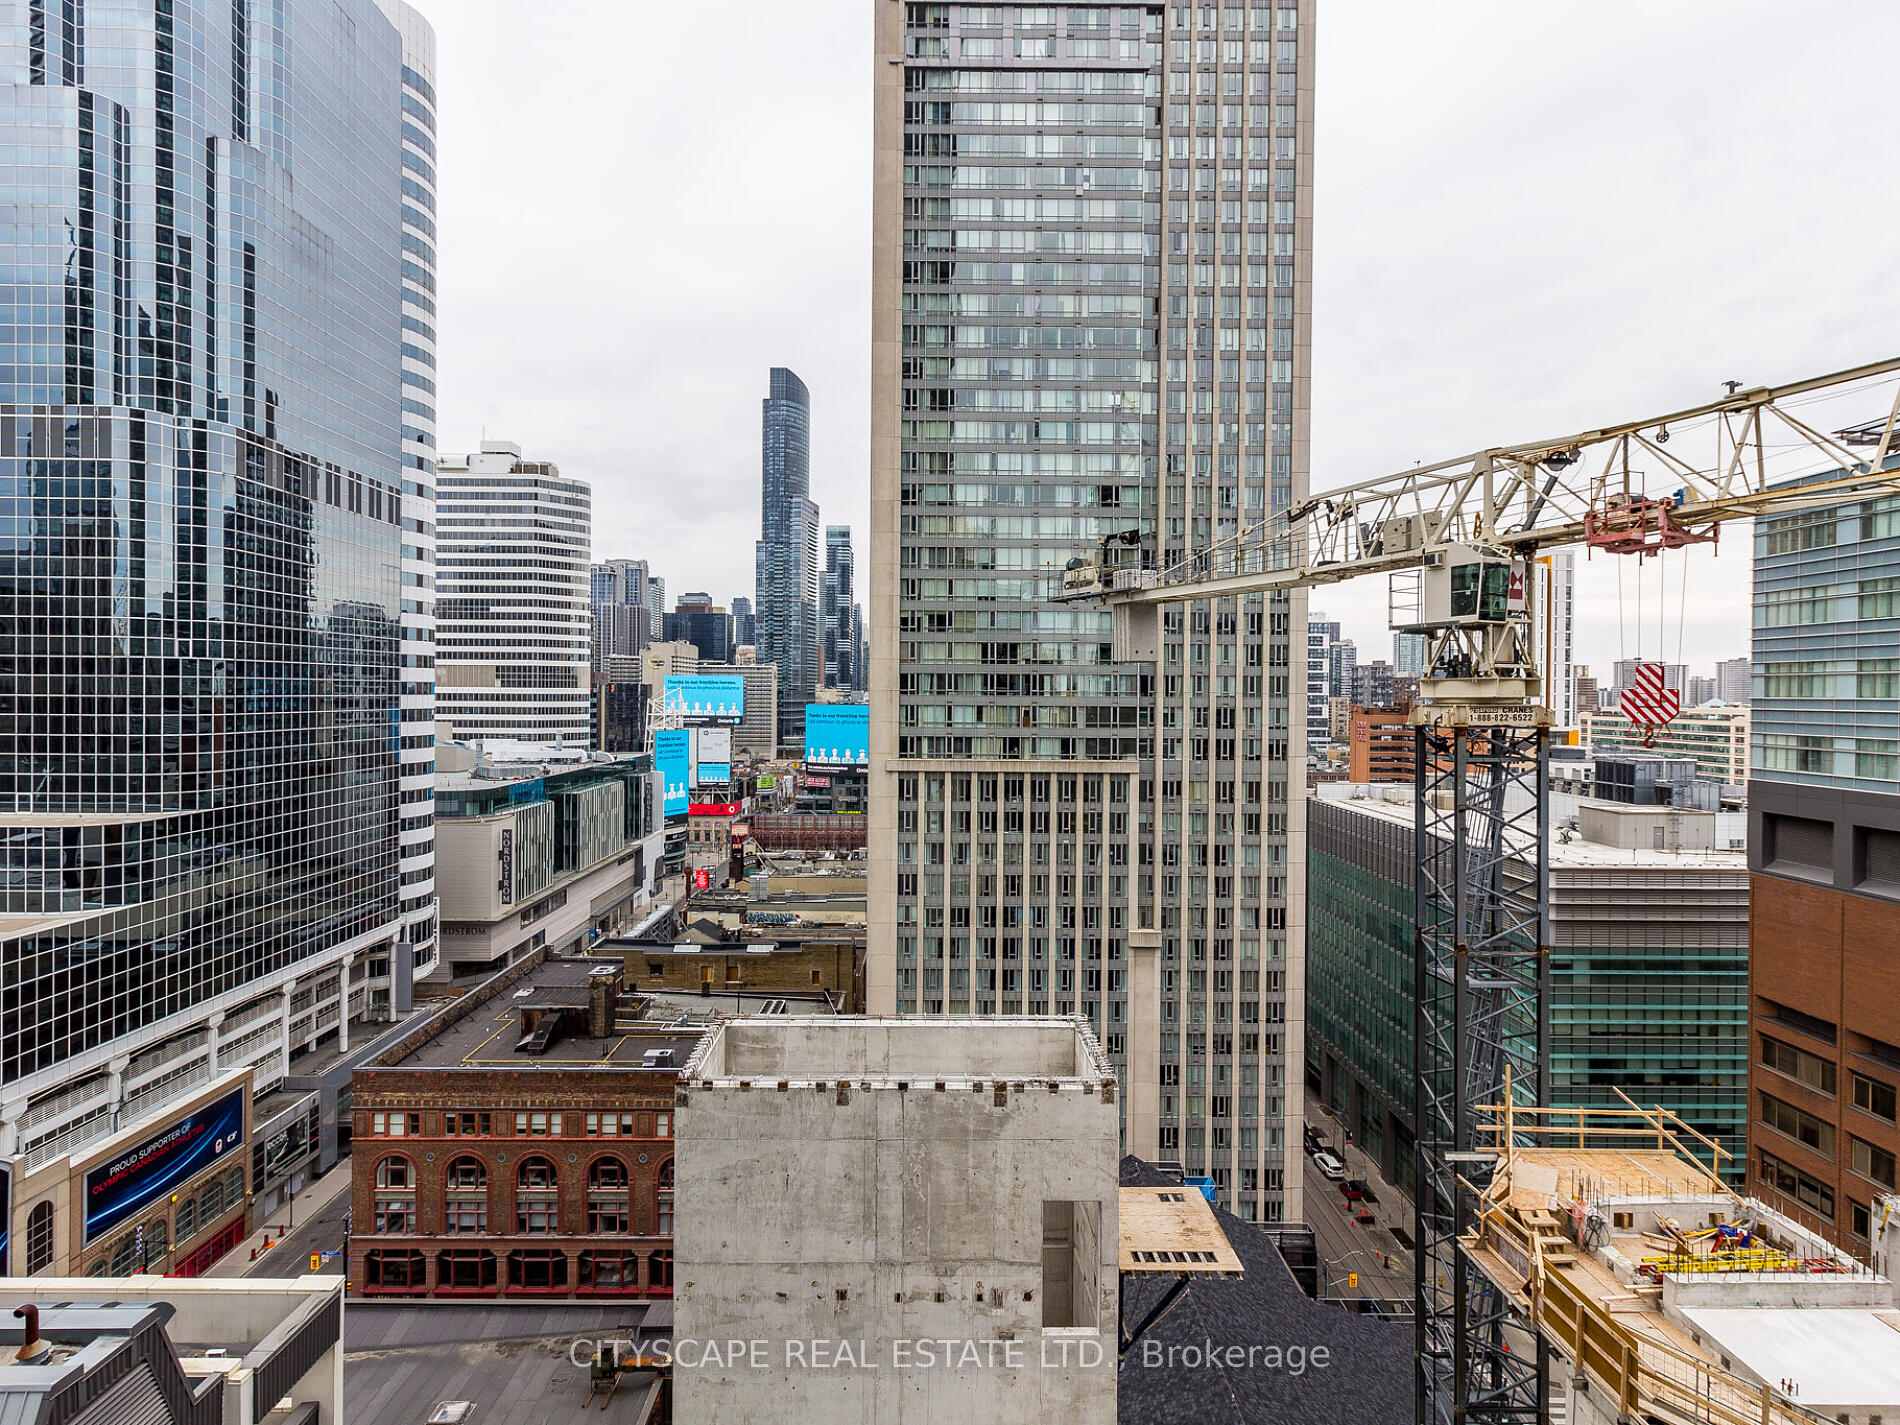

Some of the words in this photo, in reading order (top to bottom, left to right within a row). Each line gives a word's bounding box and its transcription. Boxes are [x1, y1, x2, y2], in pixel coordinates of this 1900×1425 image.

[502, 831, 511, 903] NORDSTROM
[109, 1154, 138, 1176] PROUD
[138, 1131, 181, 1160] SUPPORTER
[180, 1121, 192, 1134] OF
